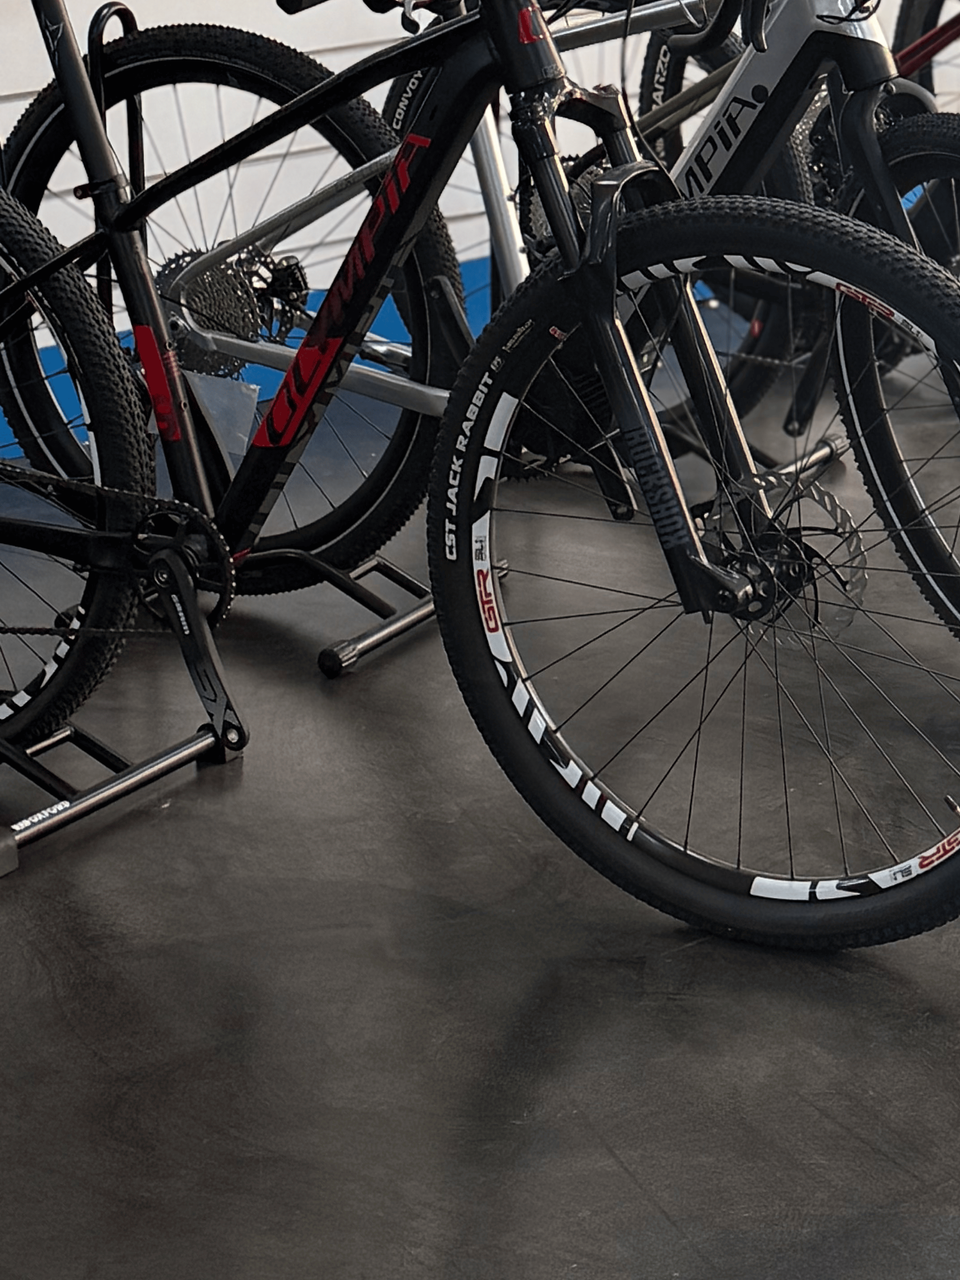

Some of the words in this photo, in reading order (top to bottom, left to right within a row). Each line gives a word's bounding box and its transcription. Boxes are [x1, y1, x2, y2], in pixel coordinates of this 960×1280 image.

[392, 70, 423, 130] CONVOY
[835, 282, 895, 318] GTR
[455, 372, 493, 453] RABBIT
[445, 455, 464, 516] JACK
[445, 518, 458, 561] CST
[475, 569, 500, 633] GTR
